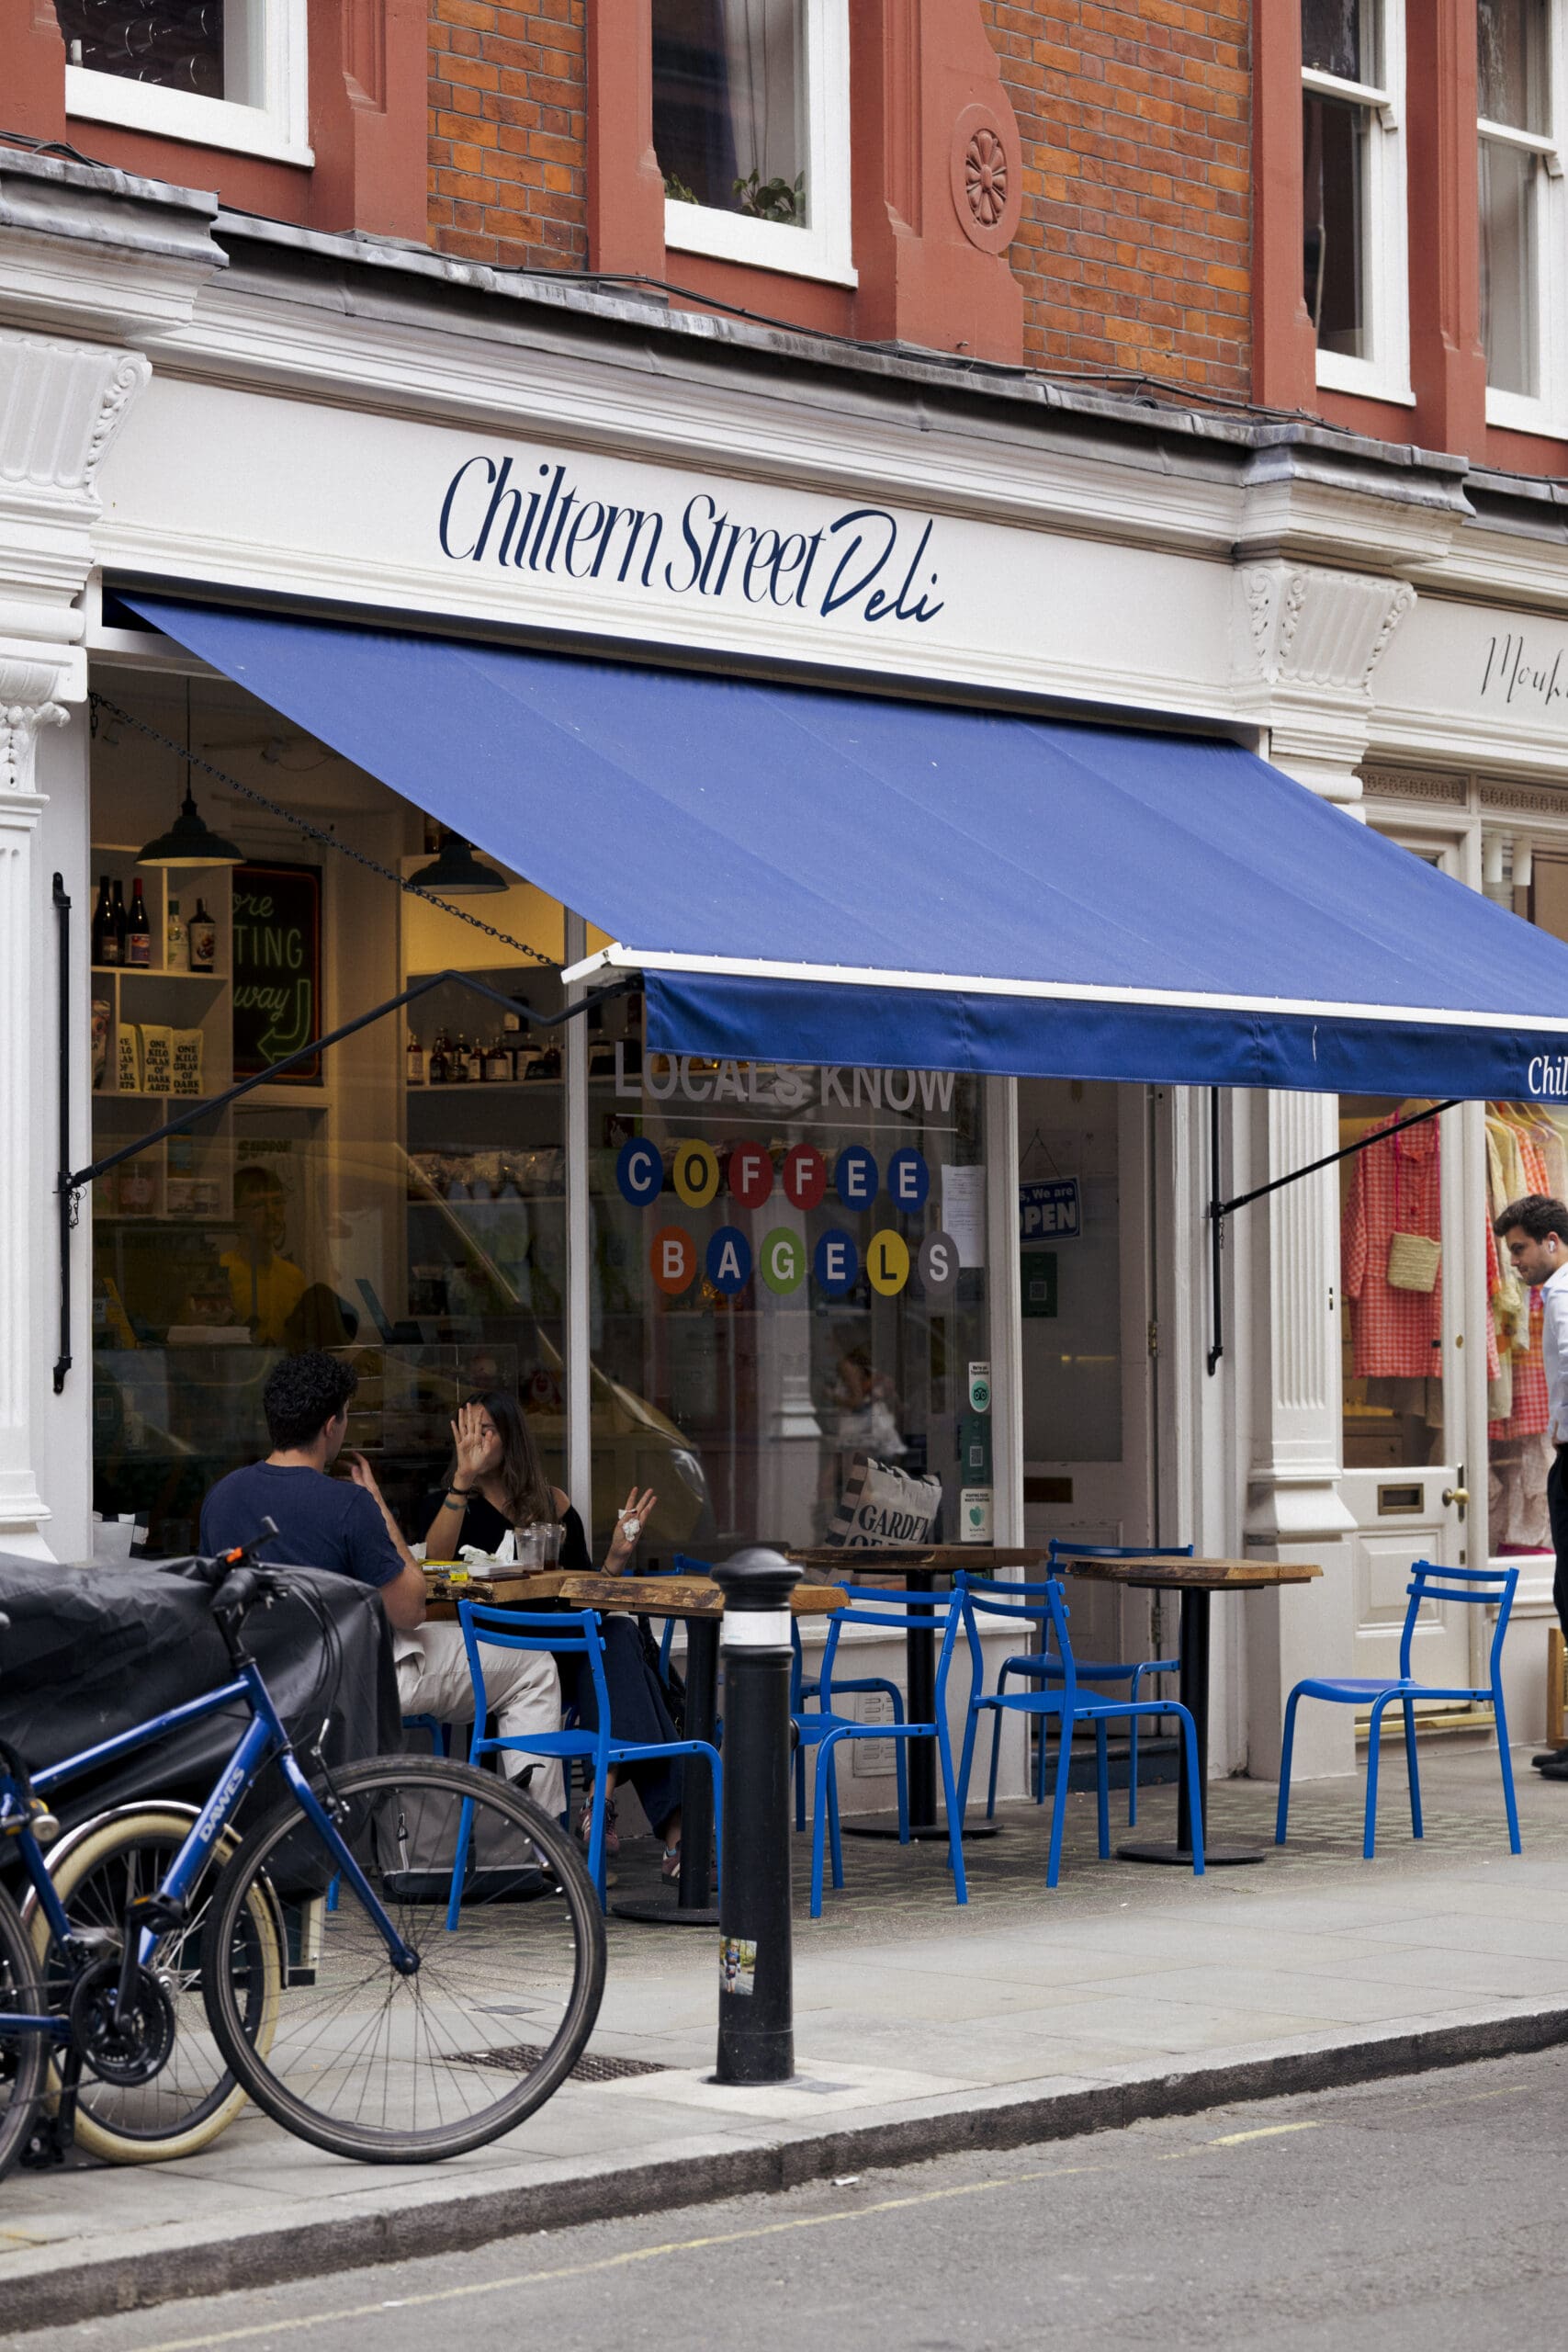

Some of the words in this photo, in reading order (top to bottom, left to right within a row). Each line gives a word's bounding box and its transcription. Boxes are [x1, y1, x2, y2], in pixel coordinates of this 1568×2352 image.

[439, 456, 663, 587] Chiltern
[664, 493, 827, 609] Street
[819, 508, 944, 623] Deli
[232, 892, 275, 918] ore
[232, 924, 303, 969] TING
[615, 1041, 804, 1103] LOCALS
[820, 1067, 955, 1112] KNOW
[628, 1151, 919, 1199] COFFEE
[662, 1240, 949, 1283] BAGELS
[858, 1504, 931, 1542] GARDEN
[199, 1767, 245, 1843] DAWES
